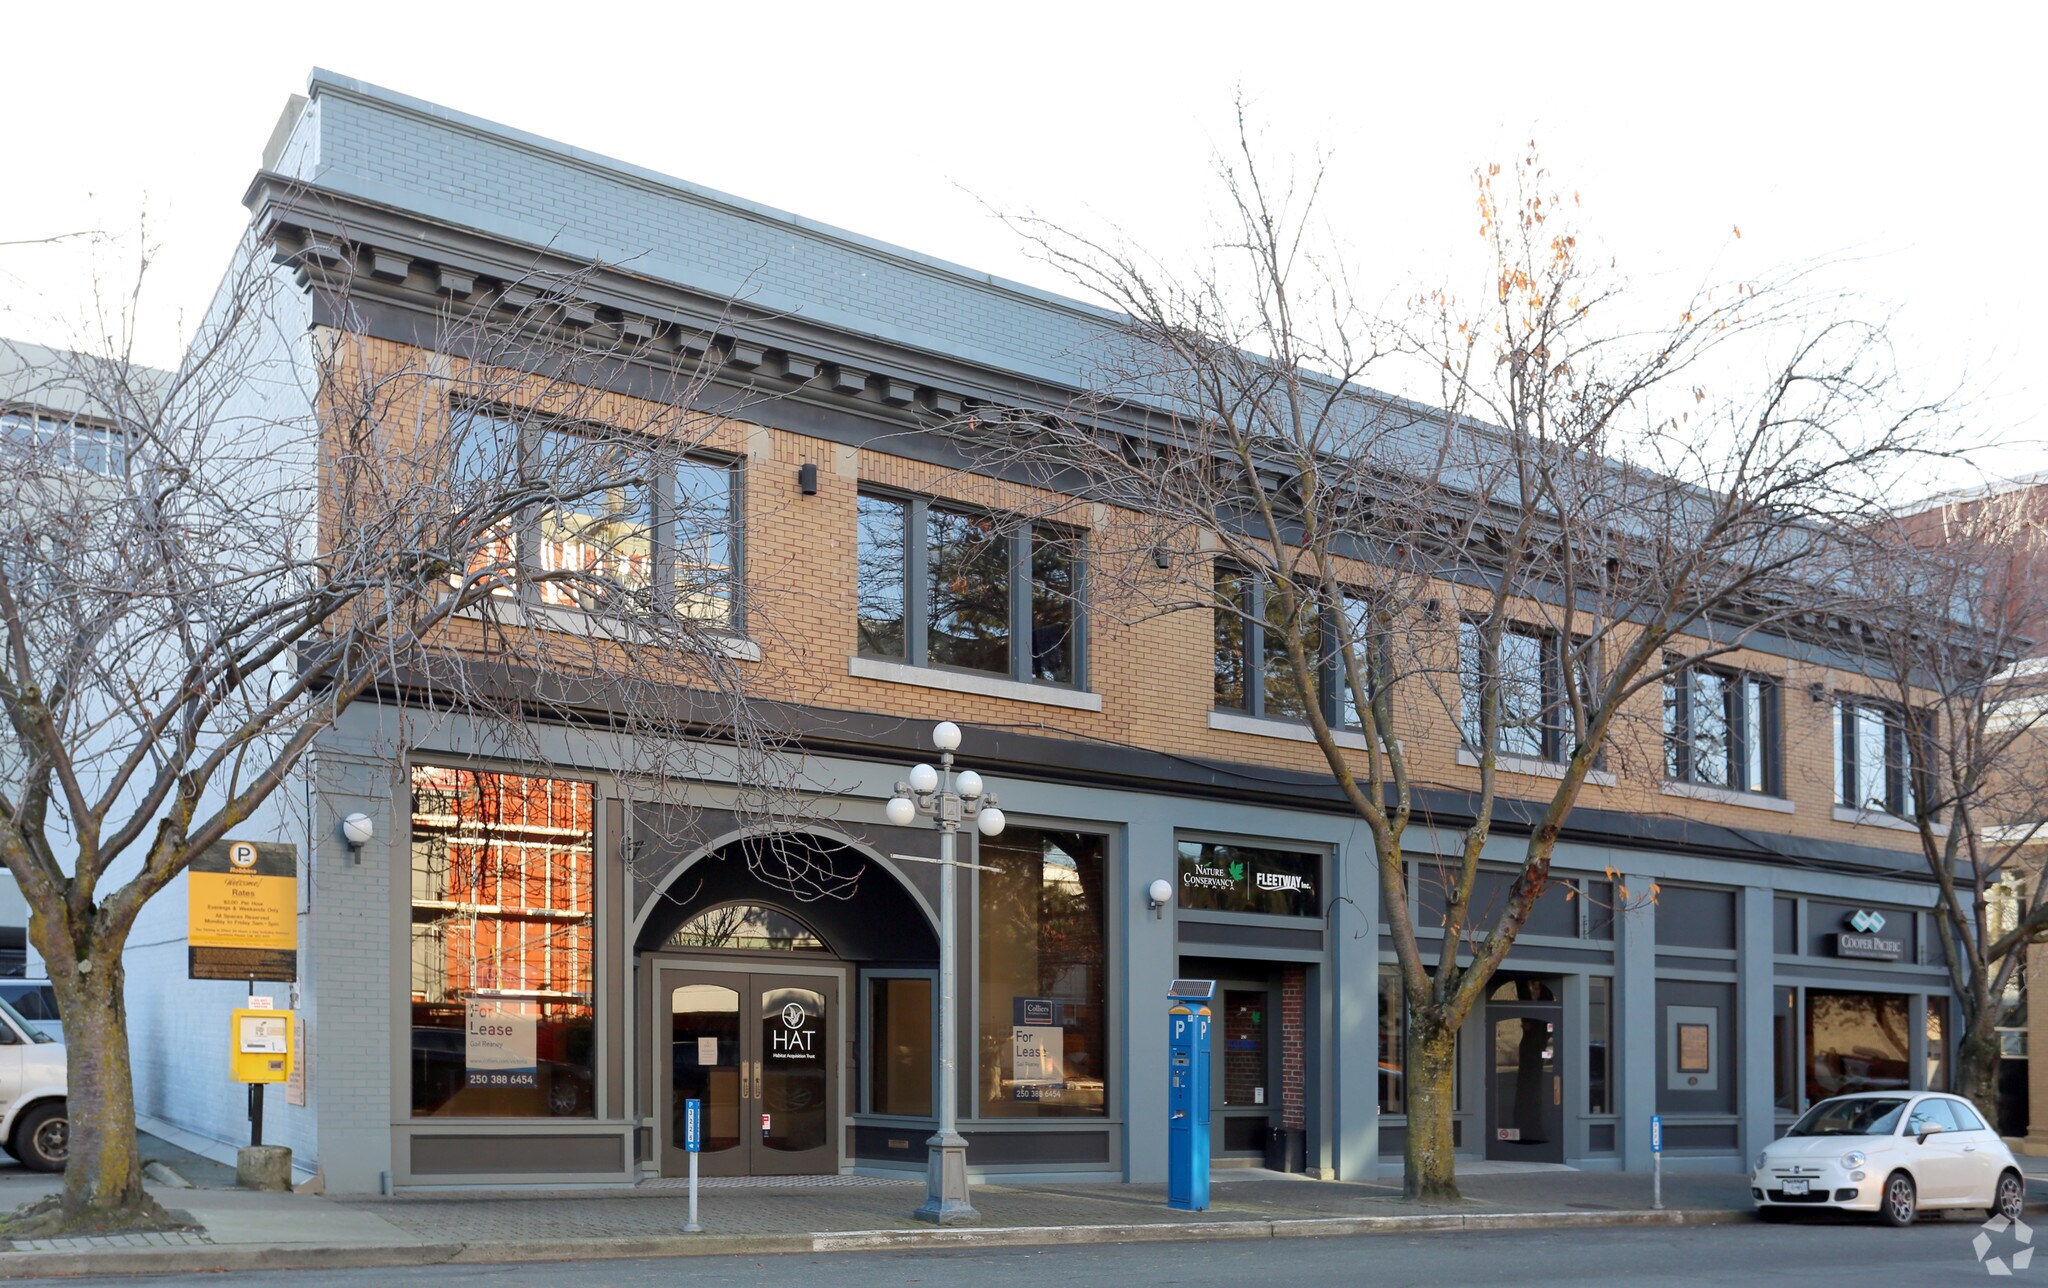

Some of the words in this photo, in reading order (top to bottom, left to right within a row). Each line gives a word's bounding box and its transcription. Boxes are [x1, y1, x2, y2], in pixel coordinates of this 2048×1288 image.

[238, 847, 250, 861] P
[1256, 872, 1302, 888] FLEETWAY
[232, 889, 255, 897] Rates
[1184, 883, 1235, 891] CANADA
[470, 1004, 494, 1018] For
[1027, 1004, 1049, 1012] Colliers
[470, 1021, 513, 1036] Lease
[1176, 1020, 1185, 1039] P
[1201, 1021, 1207, 1040] P
[773, 1030, 816, 1050] HAT
[1016, 1030, 1033, 1043] For
[1016, 1045, 1047, 1057] Lease
[470, 1075, 488, 1084] 250
[490, 1075, 507, 1084] 388
[510, 1075, 533, 1084] 6454
[1016, 1090, 1029, 1098] 250
[1044, 1090, 1061, 1098] 6454
